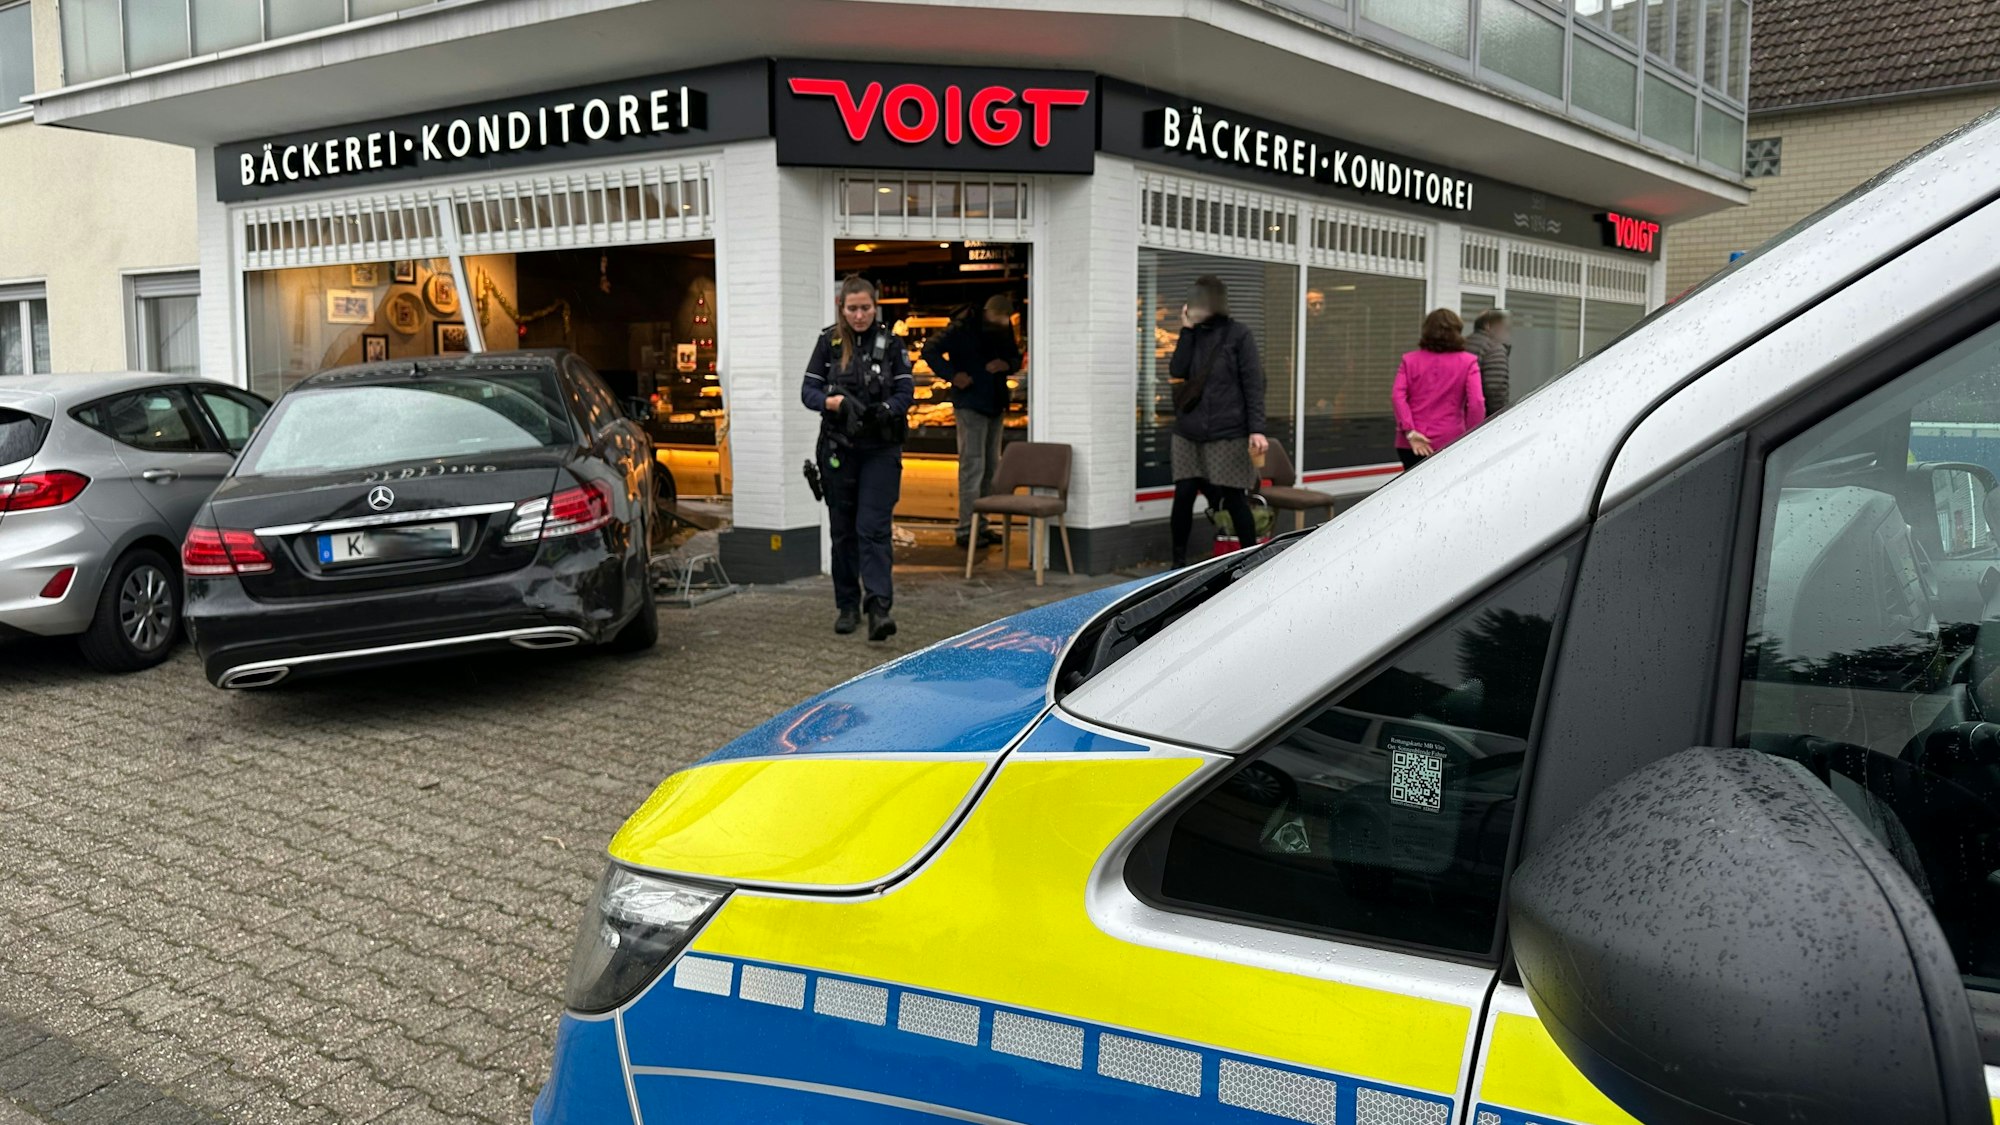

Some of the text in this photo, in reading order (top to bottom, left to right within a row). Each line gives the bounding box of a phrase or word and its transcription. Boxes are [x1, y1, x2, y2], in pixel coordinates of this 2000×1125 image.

[788, 77, 1090, 147] VOIGT
[1607, 211, 1660, 254] VOIGT
[347, 535, 362, 556] K
